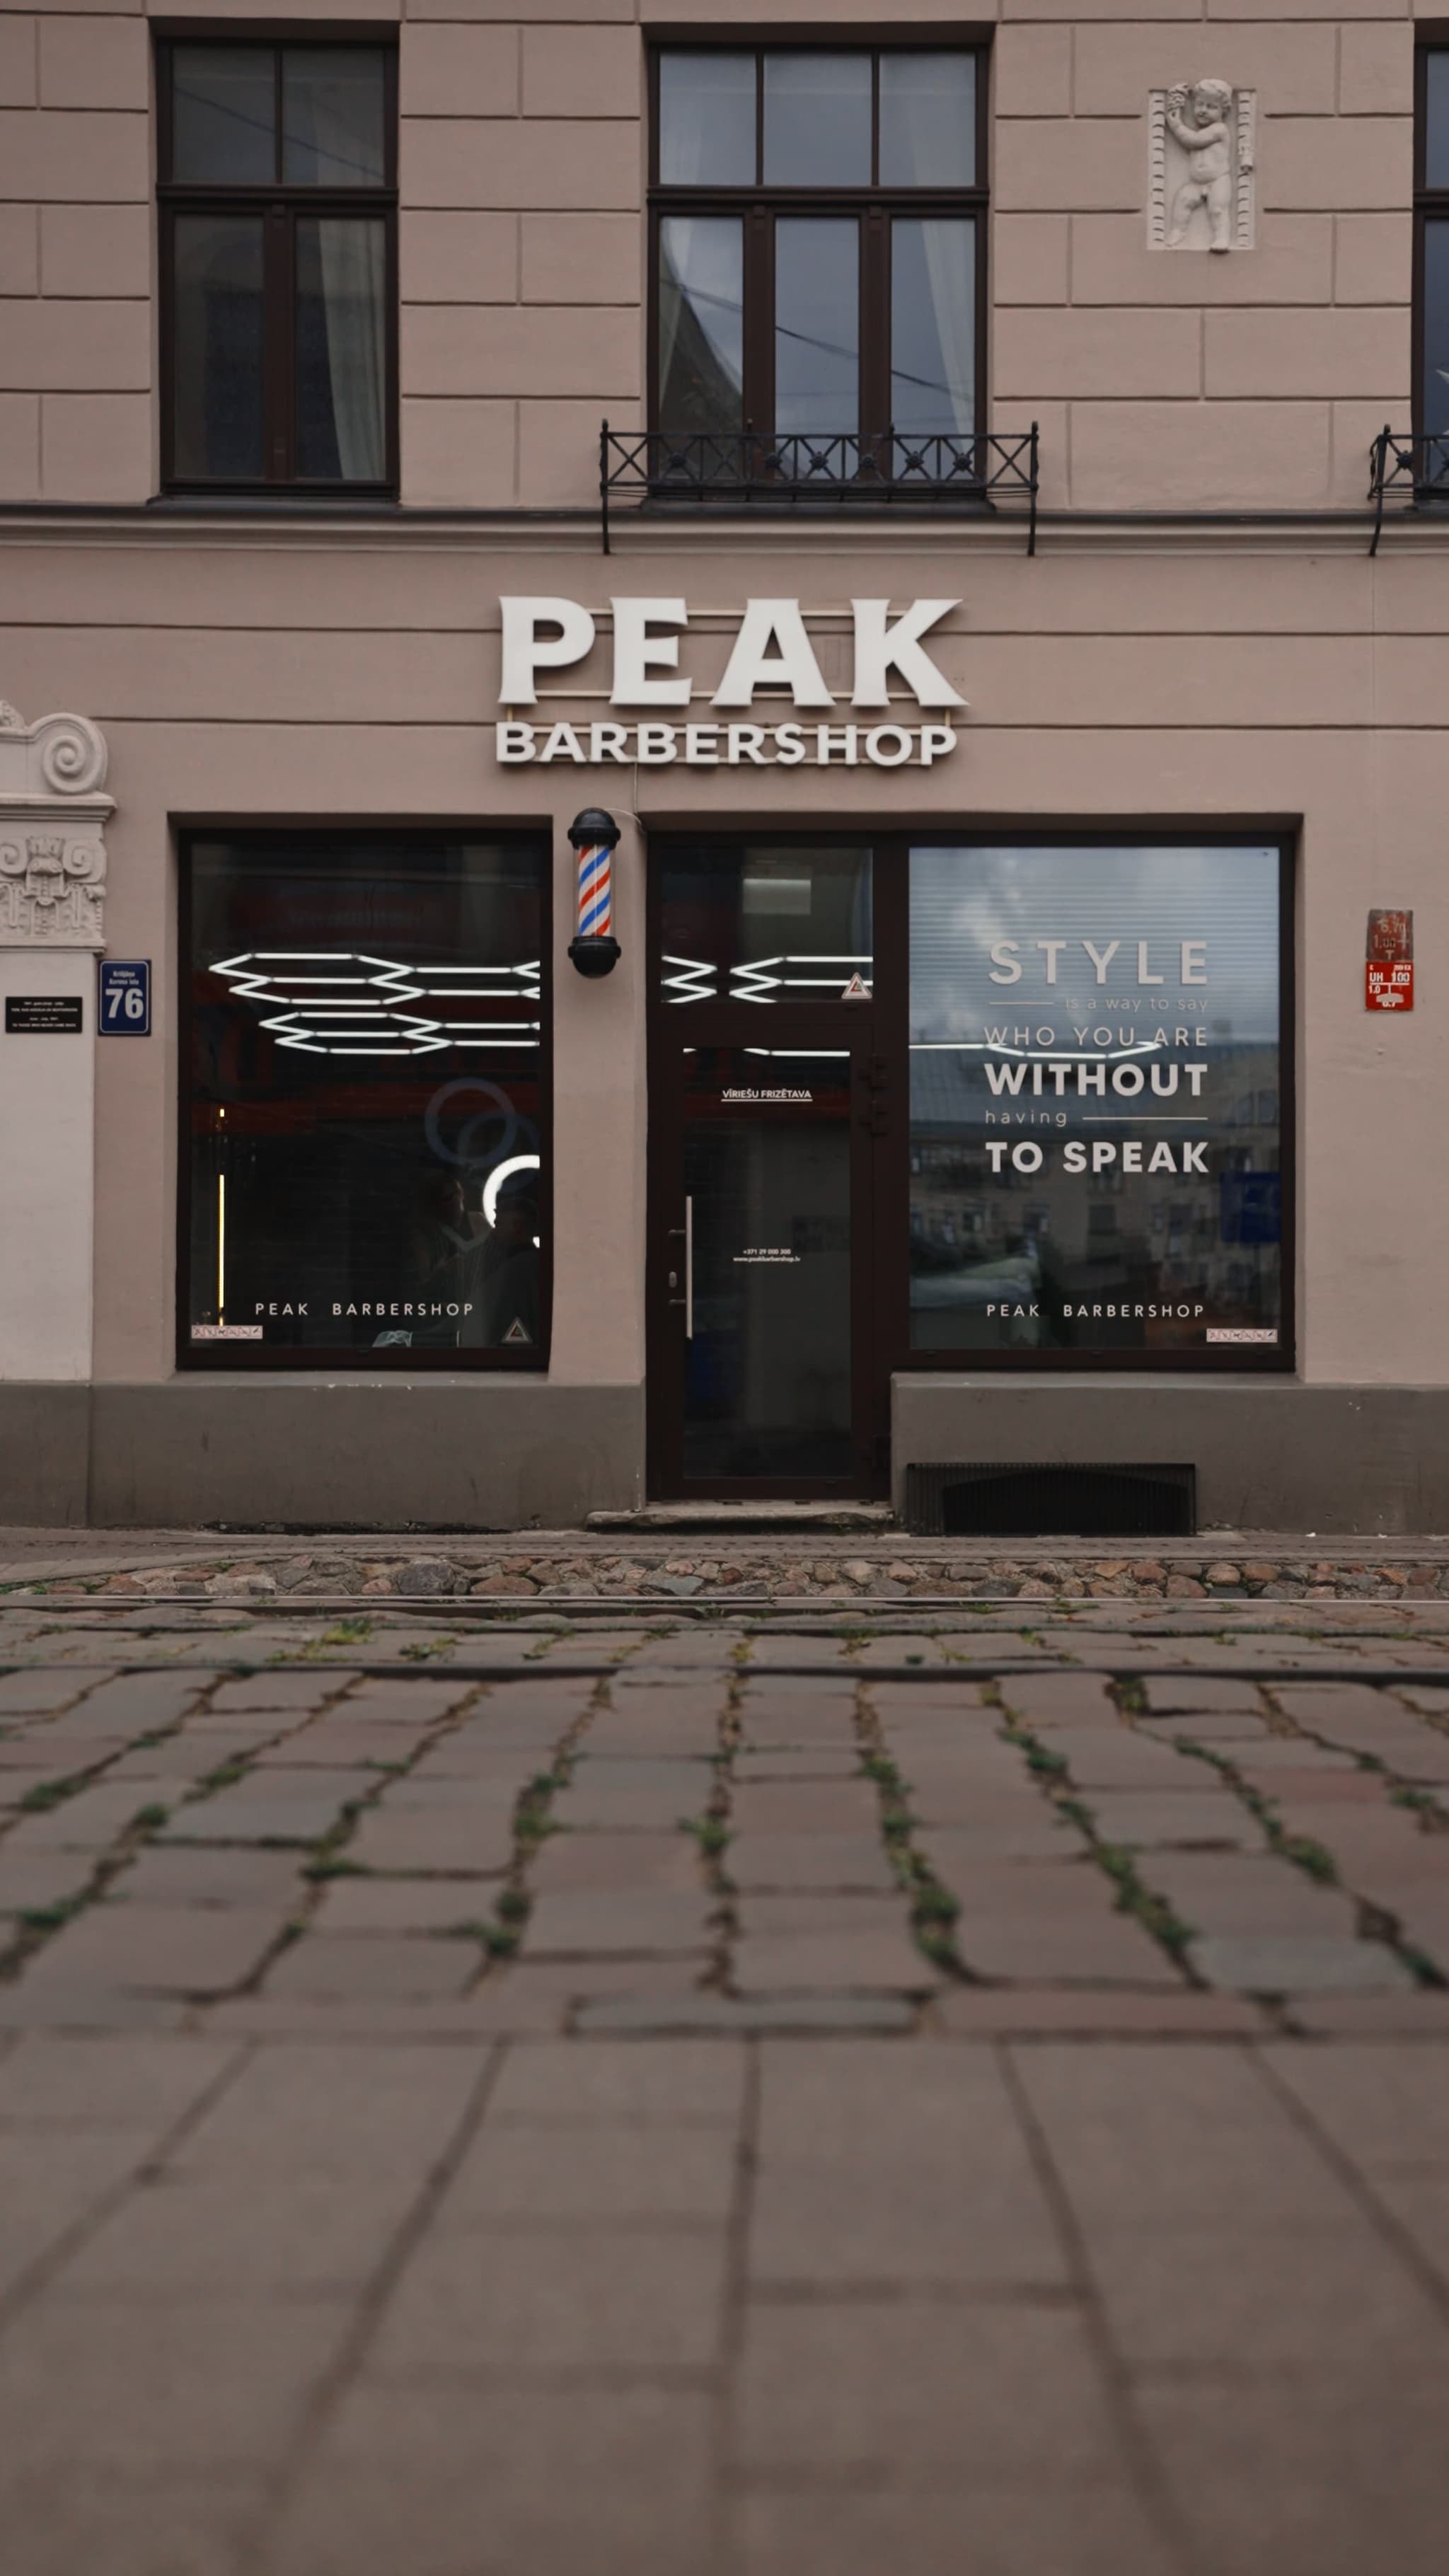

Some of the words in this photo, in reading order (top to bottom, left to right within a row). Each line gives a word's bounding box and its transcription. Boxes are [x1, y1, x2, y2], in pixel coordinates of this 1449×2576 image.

[497, 596, 970, 706] PEAK
[495, 721, 957, 766] BARBERSHOP
[988, 940, 1208, 985] STYLE
[1369, 971, 1384, 983] UH
[1392, 971, 1410, 983] 100
[105, 988, 144, 1019] 76
[1066, 997, 1079, 1010] is
[1087, 999, 1097, 1010] a
[1105, 999, 1141, 1012] way
[1150, 998, 1170, 1010] to
[1177, 999, 1208, 1012] say
[984, 1027, 1056, 1046] WHO
[1073, 1027, 1135, 1046] YOU
[1154, 1027, 1207, 1046] ARE
[983, 1063, 1208, 1097] WITHOUT
[722, 1088, 759, 1098] VĪRIEŠU
[761, 1088, 812, 1098] FRIZĒTAVA
[985, 1109, 1067, 1128] having
[985, 1141, 1043, 1173] TO
[1063, 1141, 1209, 1173] SPEAK
[255, 1303, 308, 1315] PEAK
[333, 1303, 473, 1316] BARBERSHOP
[987, 1304, 1039, 1317] PEAK
[1063, 1304, 1204, 1317] BARBERSHOP
